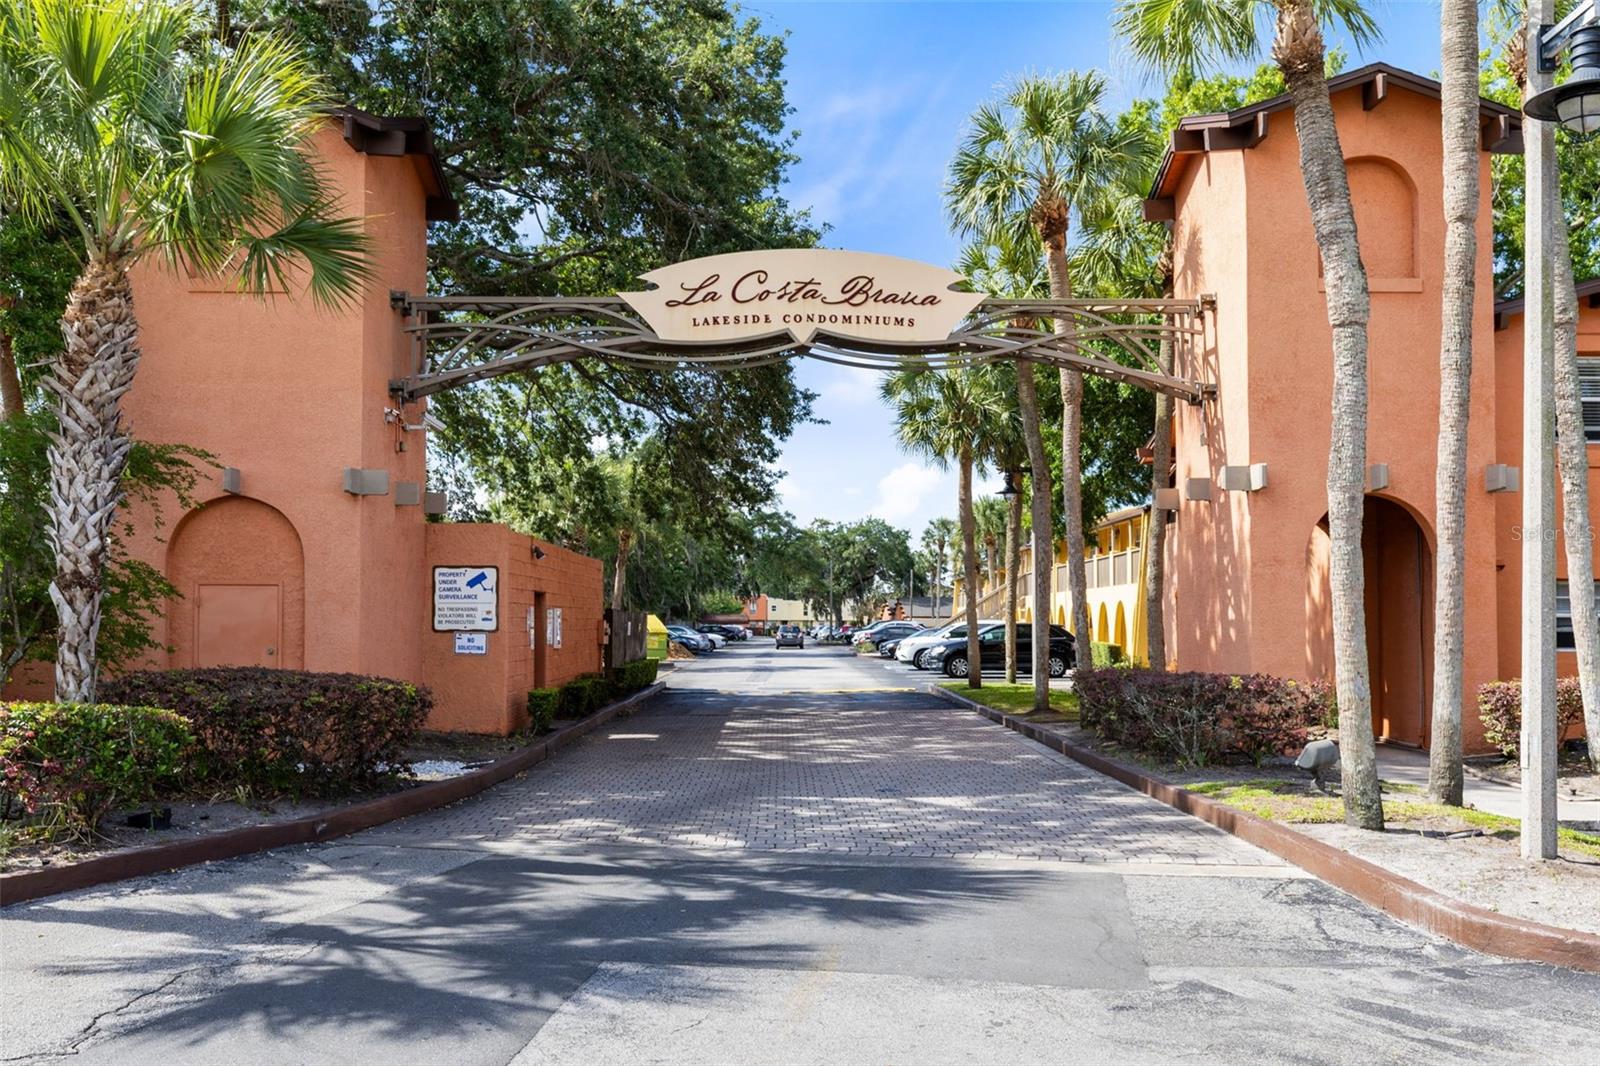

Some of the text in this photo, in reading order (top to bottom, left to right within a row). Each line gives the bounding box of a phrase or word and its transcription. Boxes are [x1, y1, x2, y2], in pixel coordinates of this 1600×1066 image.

[665, 269, 942, 307] La Costa Brava
[692, 313, 916, 328] LAKESIDE CONDOMINIUMS
